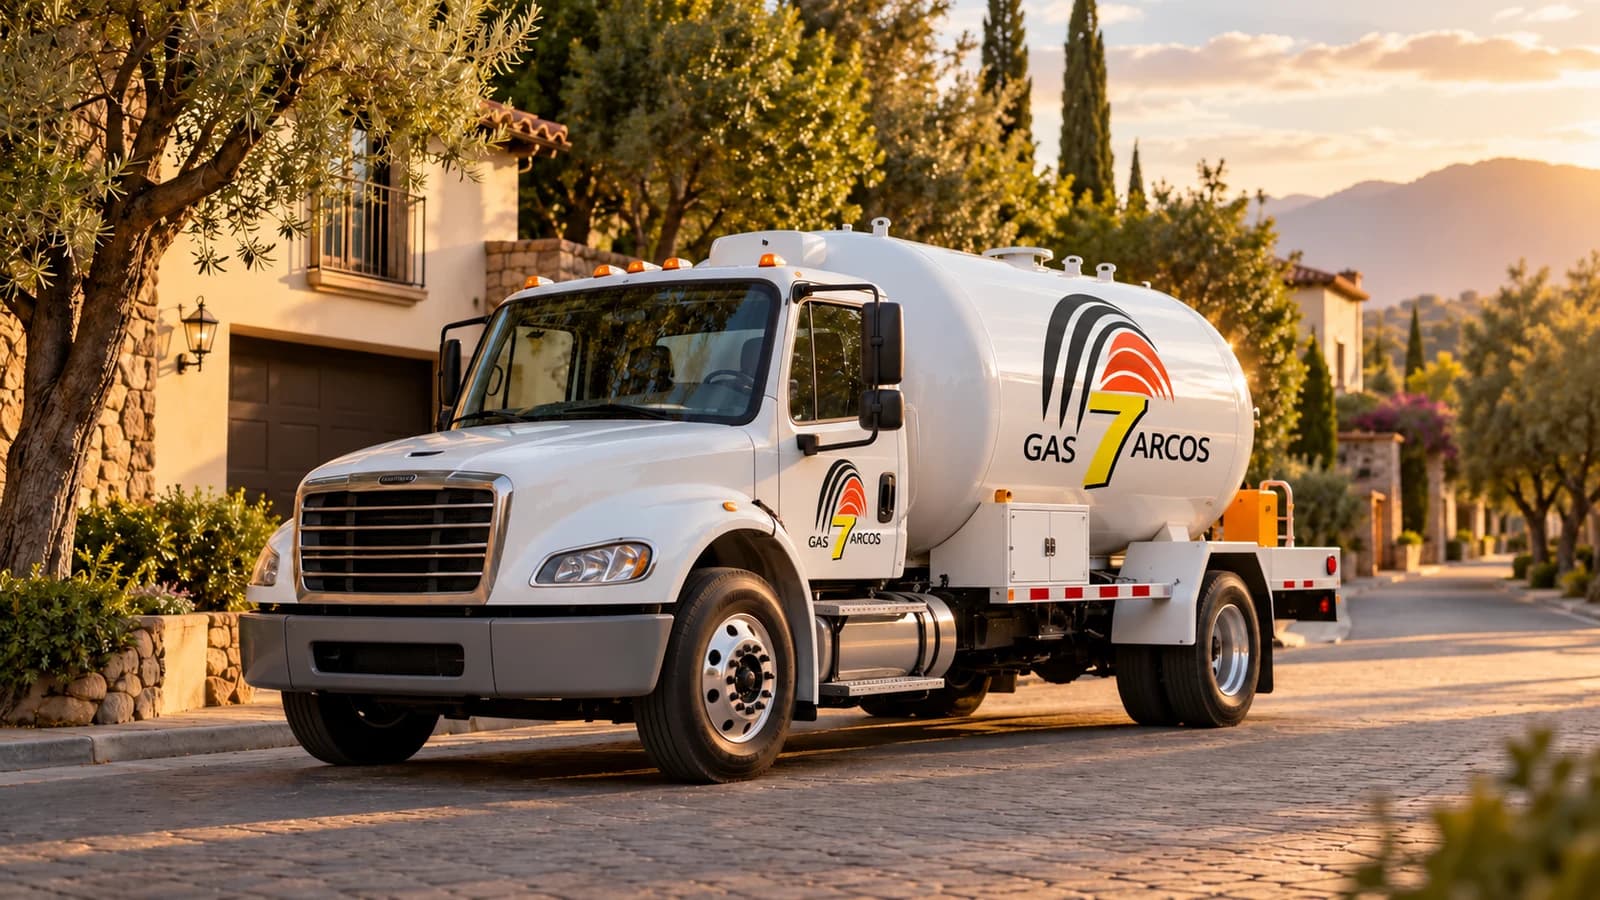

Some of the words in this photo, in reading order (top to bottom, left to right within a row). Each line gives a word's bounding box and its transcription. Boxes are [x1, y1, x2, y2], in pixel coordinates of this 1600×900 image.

[1023, 433, 1077, 463] GAS
[1081, 391, 1149, 490] 7
[1130, 431, 1210, 463] ARCOS
[808, 535, 829, 548] GAS
[831, 515, 857, 561] 7
[849, 532, 881, 545] ARCOS
